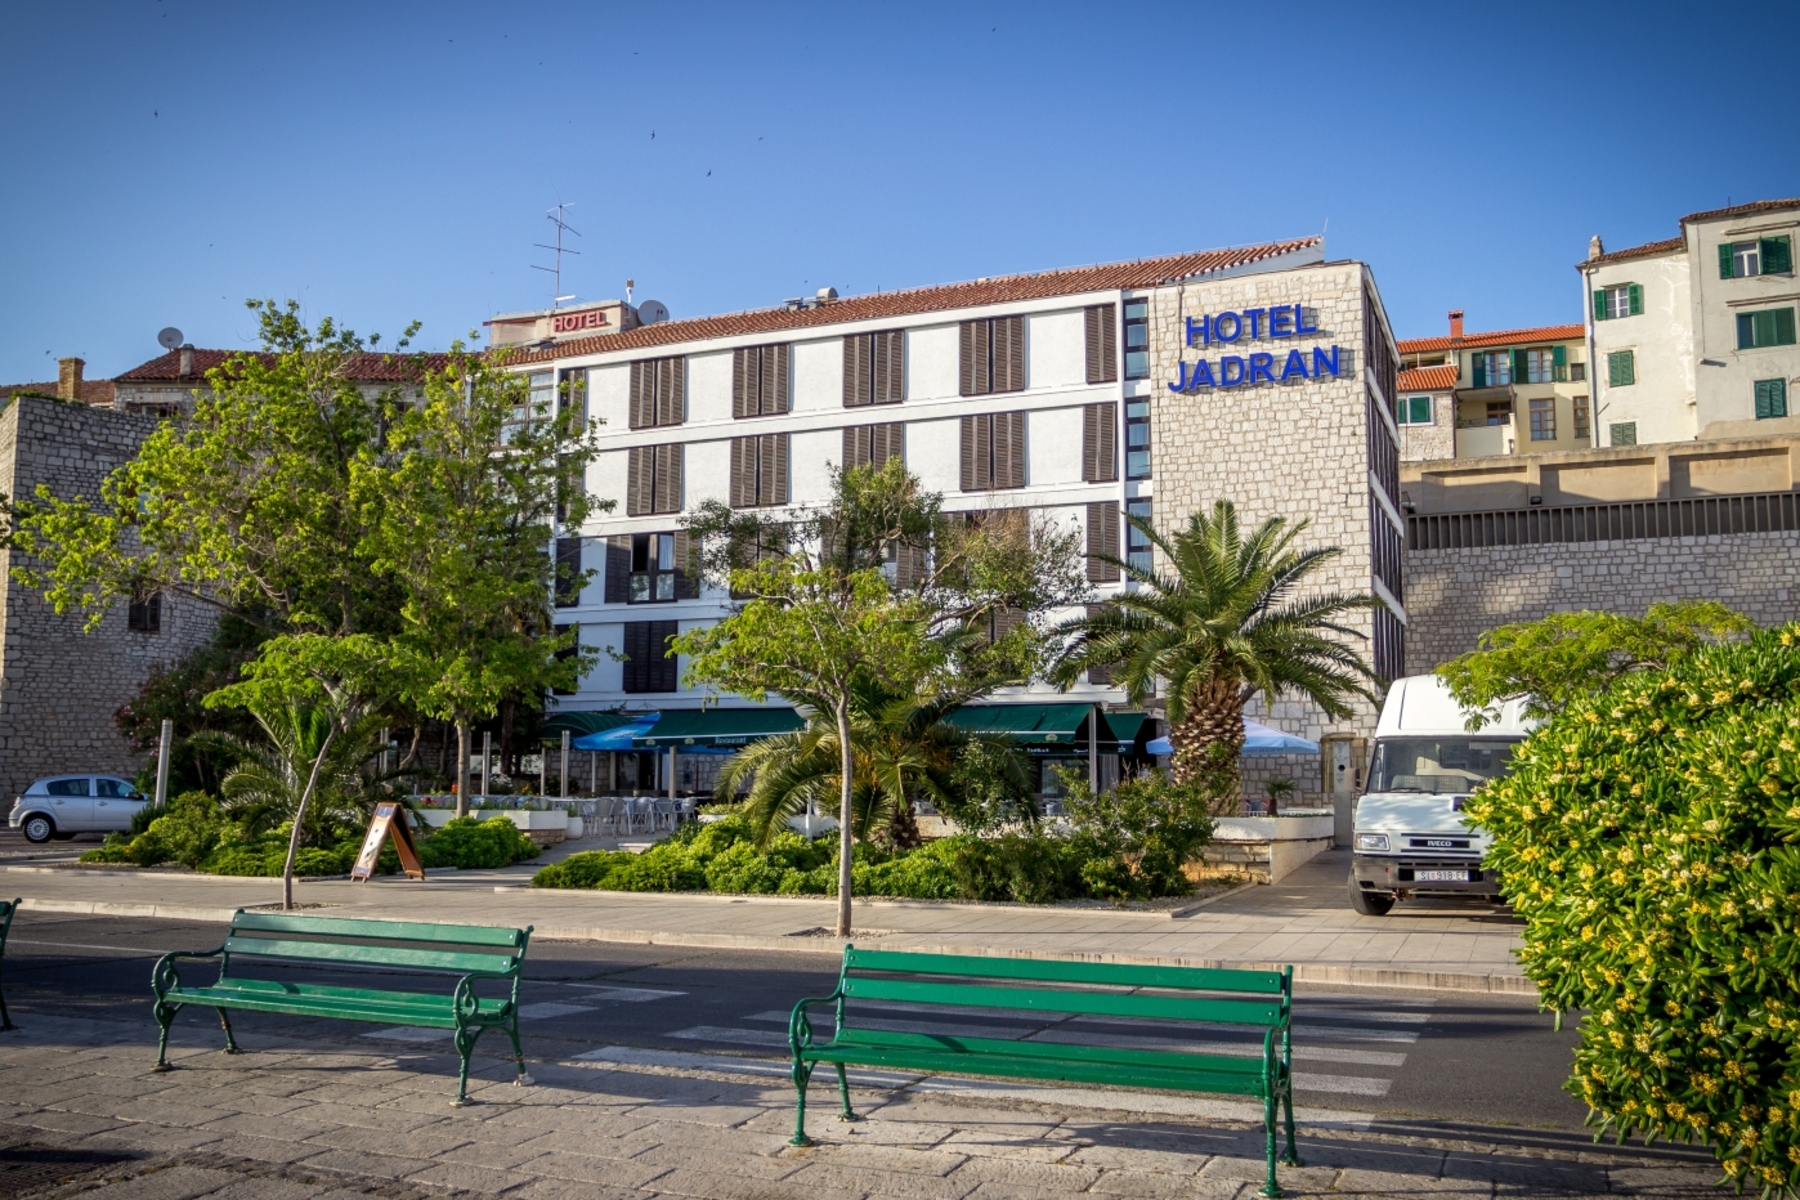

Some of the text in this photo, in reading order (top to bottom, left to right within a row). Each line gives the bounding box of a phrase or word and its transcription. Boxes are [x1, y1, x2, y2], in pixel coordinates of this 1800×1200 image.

[553, 310, 606, 332] HOTEL
[1186, 303, 1318, 346] HOTEL
[1167, 344, 1340, 393] JADRAN
